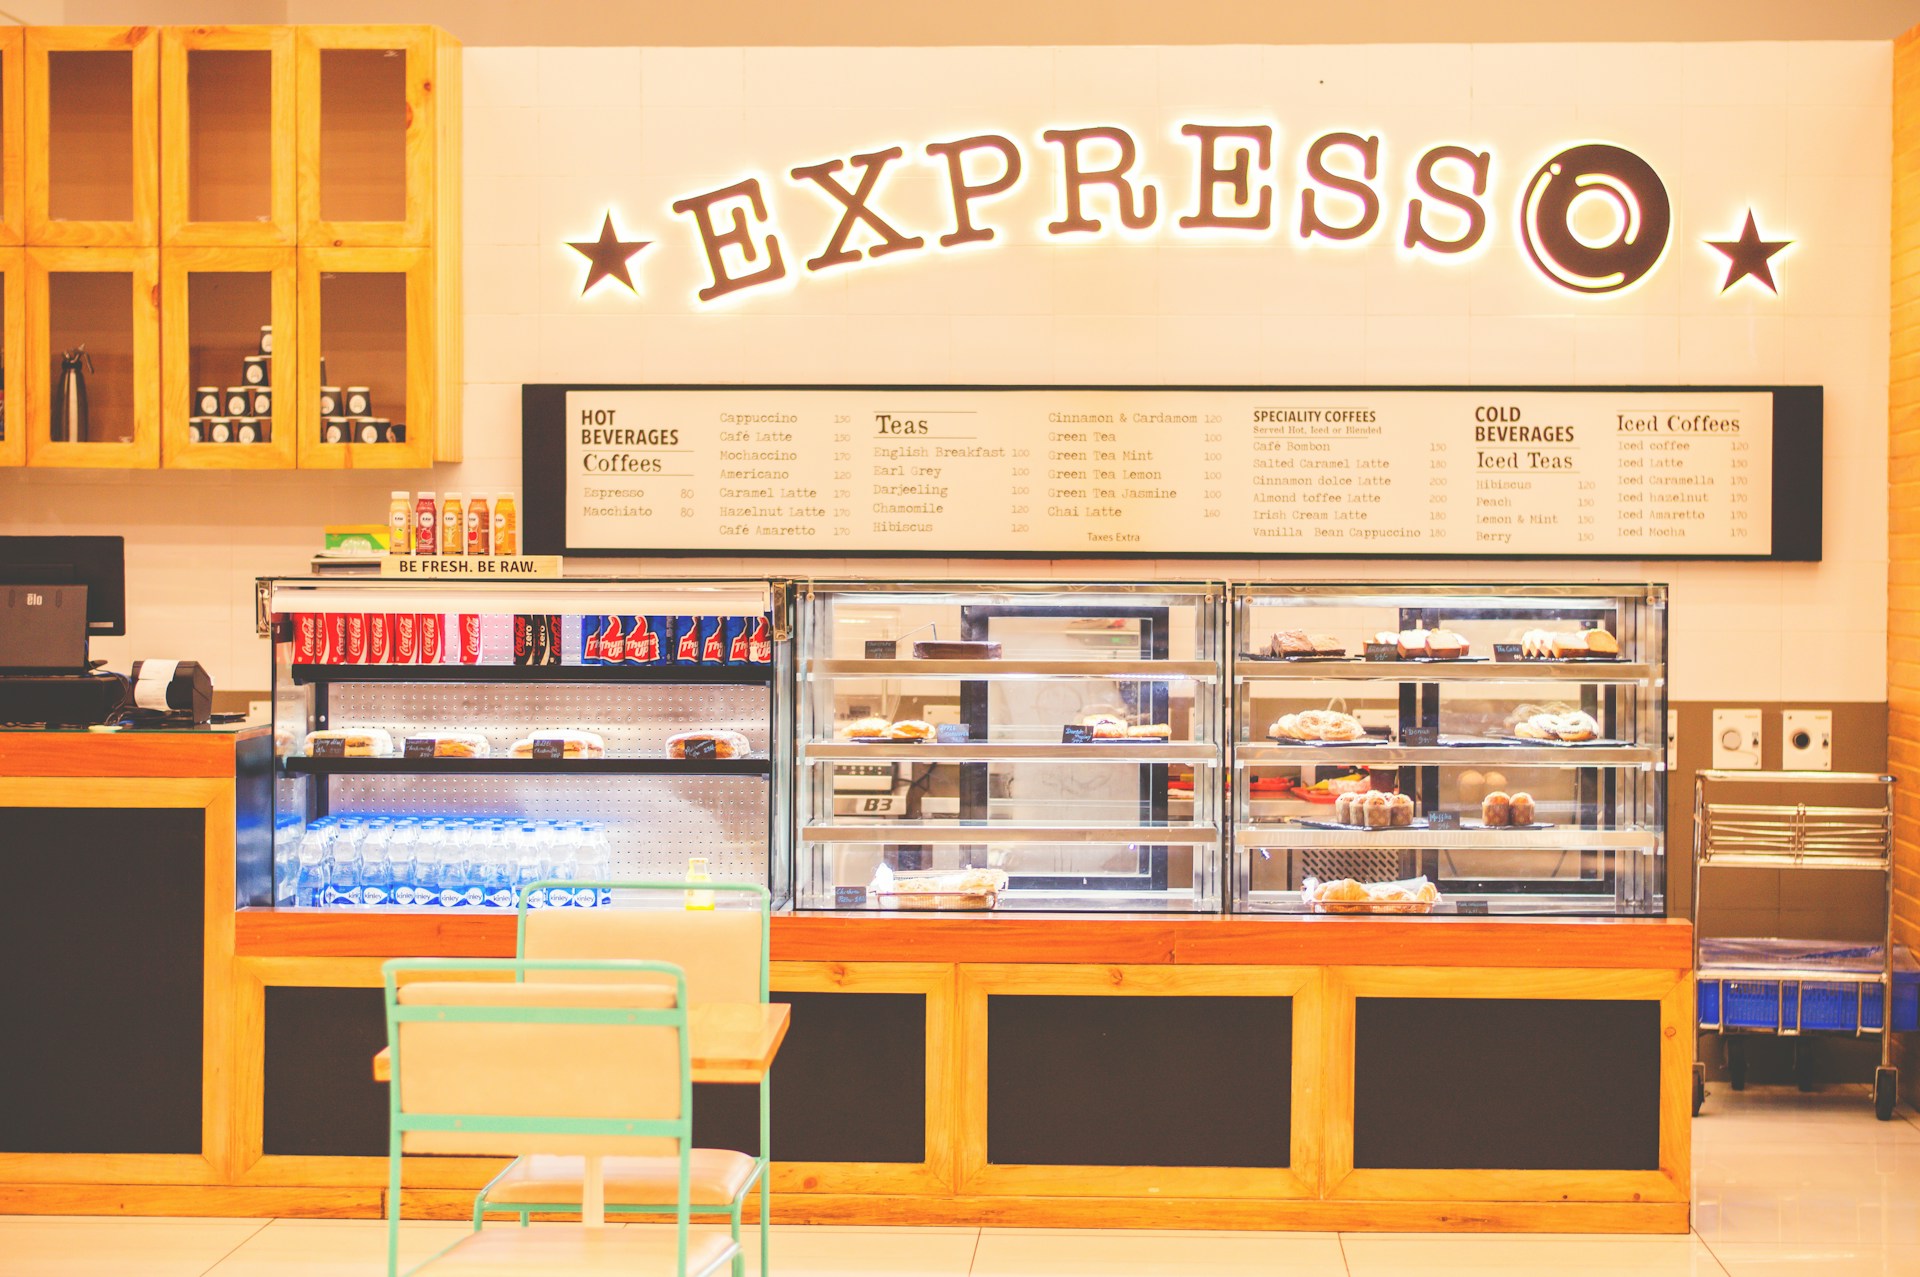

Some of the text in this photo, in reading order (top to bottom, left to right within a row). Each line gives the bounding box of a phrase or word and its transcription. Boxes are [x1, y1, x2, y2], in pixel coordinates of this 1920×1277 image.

[672, 122, 1671, 302] EXPRESSO
[582, 410, 616, 425] HOT
[720, 413, 797, 425] Cappuccino
[1049, 412, 1114, 423] Cinnamon
[1119, 413, 1127, 422] &
[1132, 412, 1198, 423] Cardamom
[1254, 411, 1376, 422] SPECIALITY COFFEES
[1475, 406, 1521, 422] COLD
[875, 415, 929, 434] Teas
[1617, 415, 1740, 431] Iced Coffees
[1311, 426, 1329, 434] Iced
[1476, 426, 1574, 442] BEVERAGES
[582, 429, 679, 445] BEVERAGES
[720, 431, 750, 441] Café
[756, 432, 792, 441] Latte
[1049, 432, 1222, 442] Green Tea 100
[1253, 441, 1281, 451] Café
[1287, 441, 1330, 451] Bombon
[1618, 441, 1644, 450] Iced
[1650, 441, 1690, 450] coffee
[720, 450, 797, 460] Mochaccino
[873, 447, 1030, 460] English Breakfast 100
[1049, 450, 1222, 461] Green Tea Mint 100
[583, 454, 662, 472] Coffees
[1253, 458, 1294, 468] Salted
[1300, 459, 1350, 468] Caramel
[1357, 459, 1389, 468] Latte
[1477, 452, 1572, 468] Iced Teas
[1618, 458, 1644, 467] Iced
[1650, 458, 1683, 467] Latte
[720, 469, 789, 479] Americano
[873, 466, 1030, 479] Earl Grey 100
[1049, 470, 1222, 480] Green Tea Lemon 100
[1253, 476, 1312, 485] Cinnamon
[1318, 476, 1352, 485] dolce
[1359, 476, 1391, 485] Latte
[1476, 480, 1532, 489] Hibiscus
[1618, 475, 1644, 485] Iced
[1649, 475, 1714, 485] Caramella
[584, 488, 694, 500] Espresso 80
[720, 488, 774, 498] Caramel
[780, 488, 817, 498] Latte
[873, 484, 1030, 498] Darjeeling 100
[1049, 488, 1222, 499] Green Tea Jasmine 100
[1253, 493, 1296, 502] Almond
[1303, 493, 1341, 502] toffee
[1348, 493, 1380, 503] Latte
[1476, 497, 1511, 506] Peach
[1618, 492, 1644, 502] Iced
[1650, 493, 1708, 502] hazelnut
[584, 506, 694, 518] Macchiato 80
[720, 506, 783, 516] Hazelnut
[789, 507, 825, 517] Latte
[873, 503, 943, 513] Chamomile
[1048, 506, 1079, 516] Chai
[1086, 506, 1122, 517] Latte
[1253, 510, 1286, 519] Irish
[1292, 511, 1328, 519] Cream
[1334, 510, 1367, 520] Latte
[1476, 515, 1513, 524] Lemon
[1517, 515, 1524, 524] &
[1530, 515, 1558, 524] Mint
[1618, 510, 1644, 519] Iced
[1650, 510, 1704, 519] Amaretto
[720, 524, 750, 535] Café
[755, 525, 815, 535] Amaretto
[873, 521, 933, 532] Hibiscus
[1618, 527, 1644, 536] Iced
[1649, 528, 1685, 536] Mocha
[1088, 532, 1140, 541] Taxes Extra
[1253, 527, 1303, 536] Vanilla
[1314, 528, 1344, 537] Bean
[1349, 528, 1420, 539] Cappuccino
[1476, 531, 1512, 543] Berry
[400, 561, 537, 573] BE FRESH. BE RAW.
[525, 625, 533, 647] zero
[864, 798, 893, 811] B3
